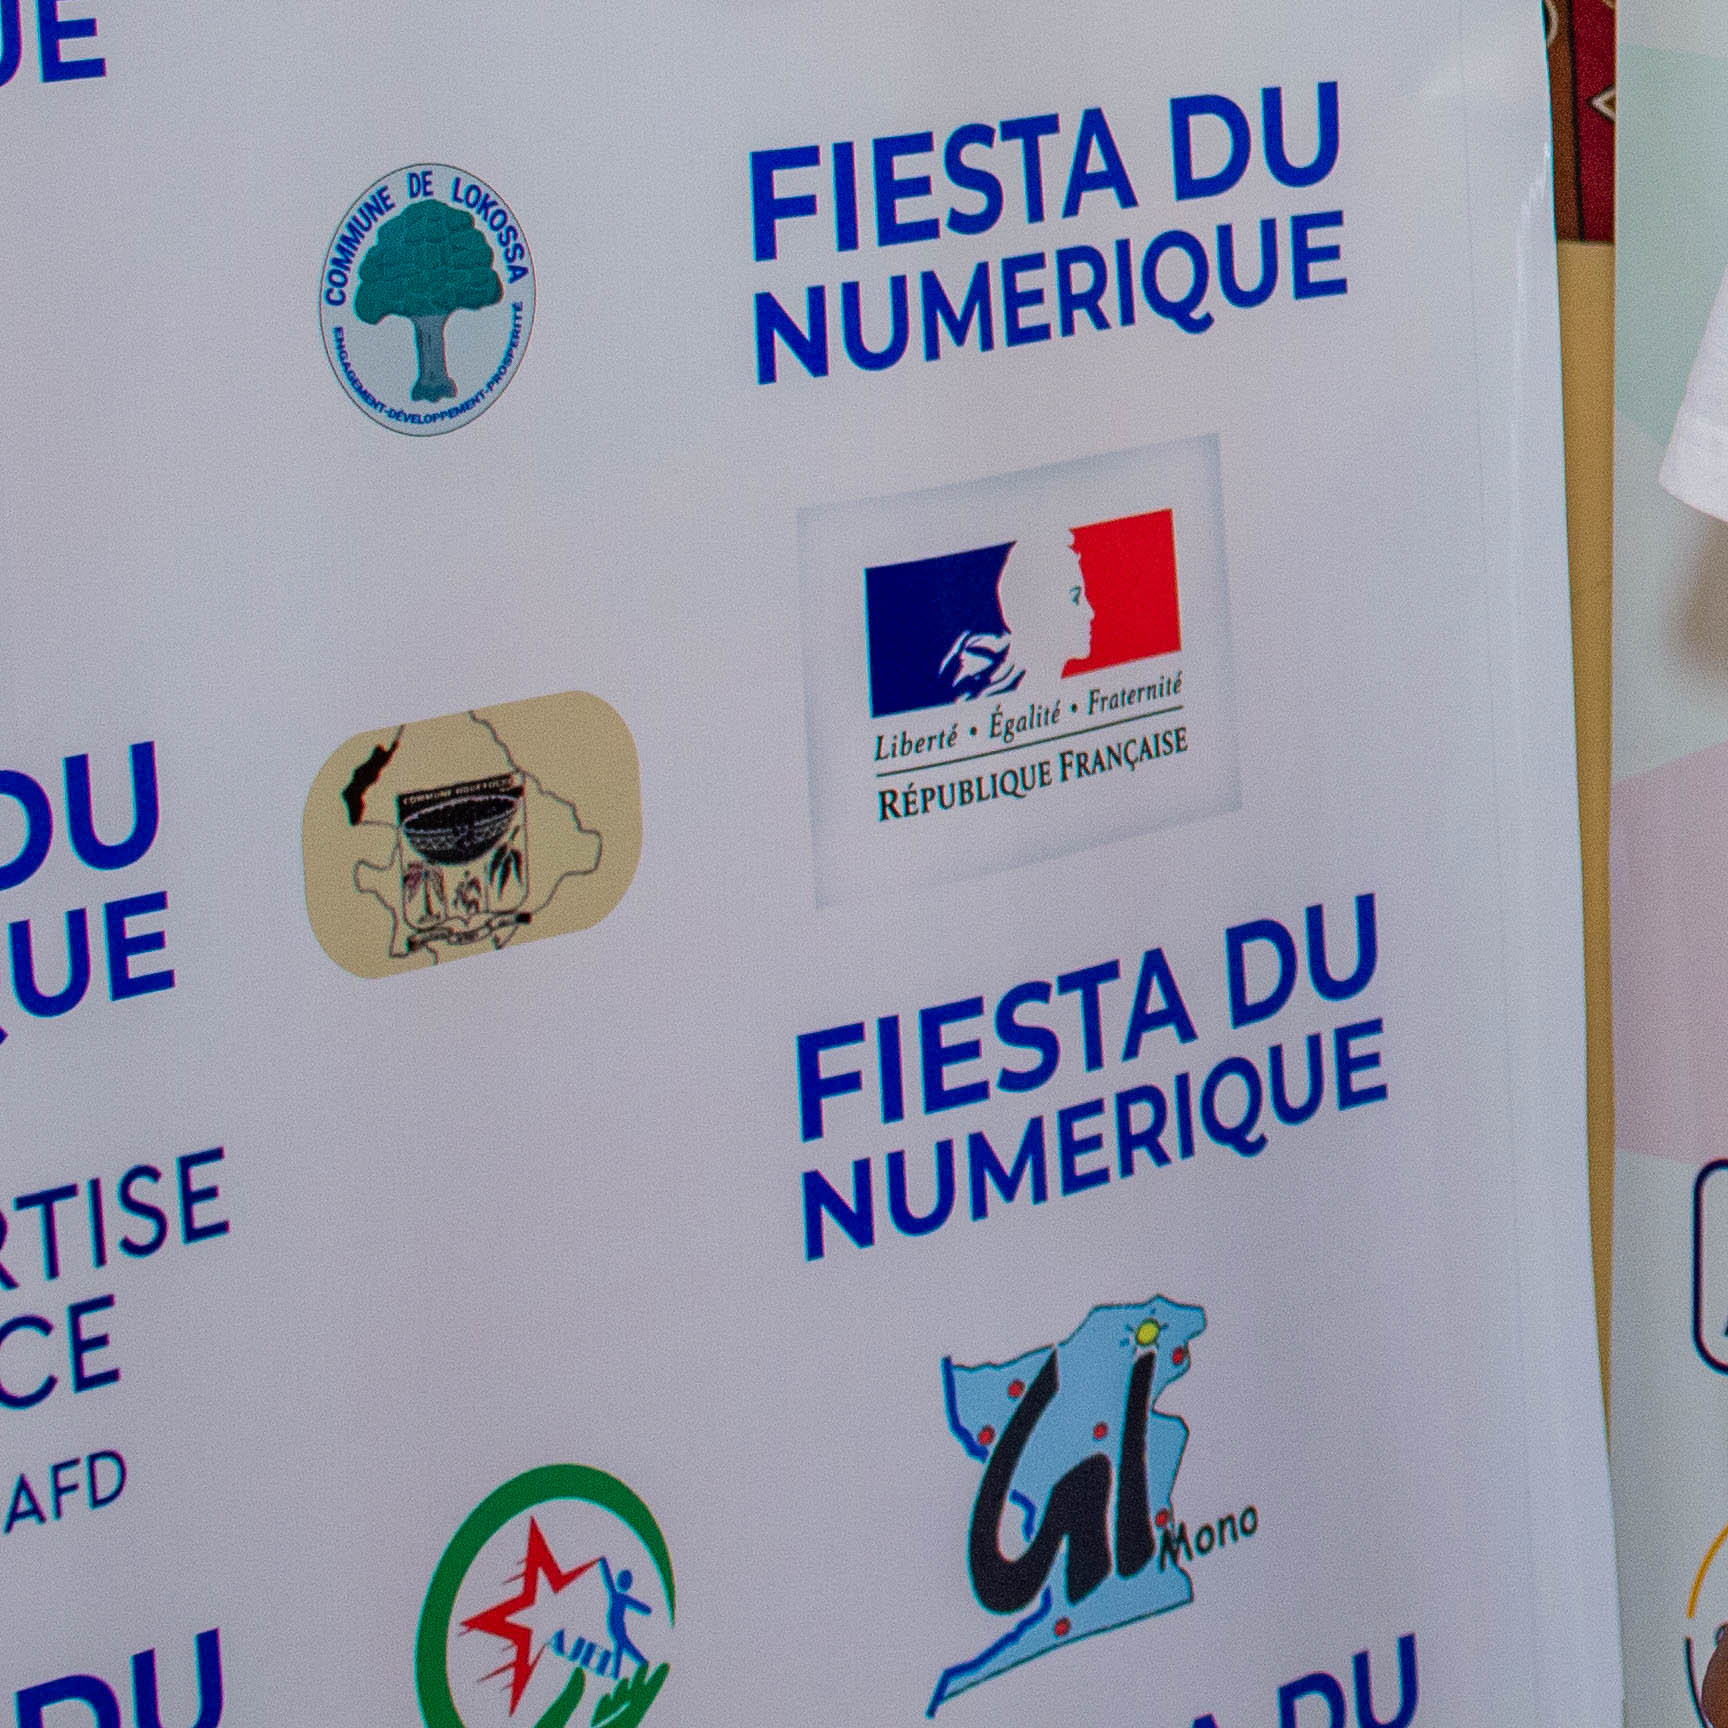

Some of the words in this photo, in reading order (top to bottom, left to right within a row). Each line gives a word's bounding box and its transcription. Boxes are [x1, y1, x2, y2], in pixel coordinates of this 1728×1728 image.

[325, 185, 396, 307] COMMUNE
[407, 170, 434, 199] DE
[451, 176, 530, 285] LOKOSSA
[750, 107, 1139, 262] FIESTA
[1170, 81, 1340, 202] DU
[753, 210, 1348, 385] NUMERIQUE
[874, 722, 960, 761] Liberté
[988, 704, 1063, 742] Égalité
[1087, 671, 1185, 716] Fraternité
[876, 760, 1054, 823] RÉPUBLIQUE
[1058, 726, 1190, 783] FRANÇAISE
[796, 947, 1200, 1143] FIESTA
[1225, 892, 1378, 1031] DU
[802, 1017, 1390, 1263] NUMERIQUE
[3, 1448, 128, 1535] AFD
[1157, 1505, 1260, 1572] Mono
